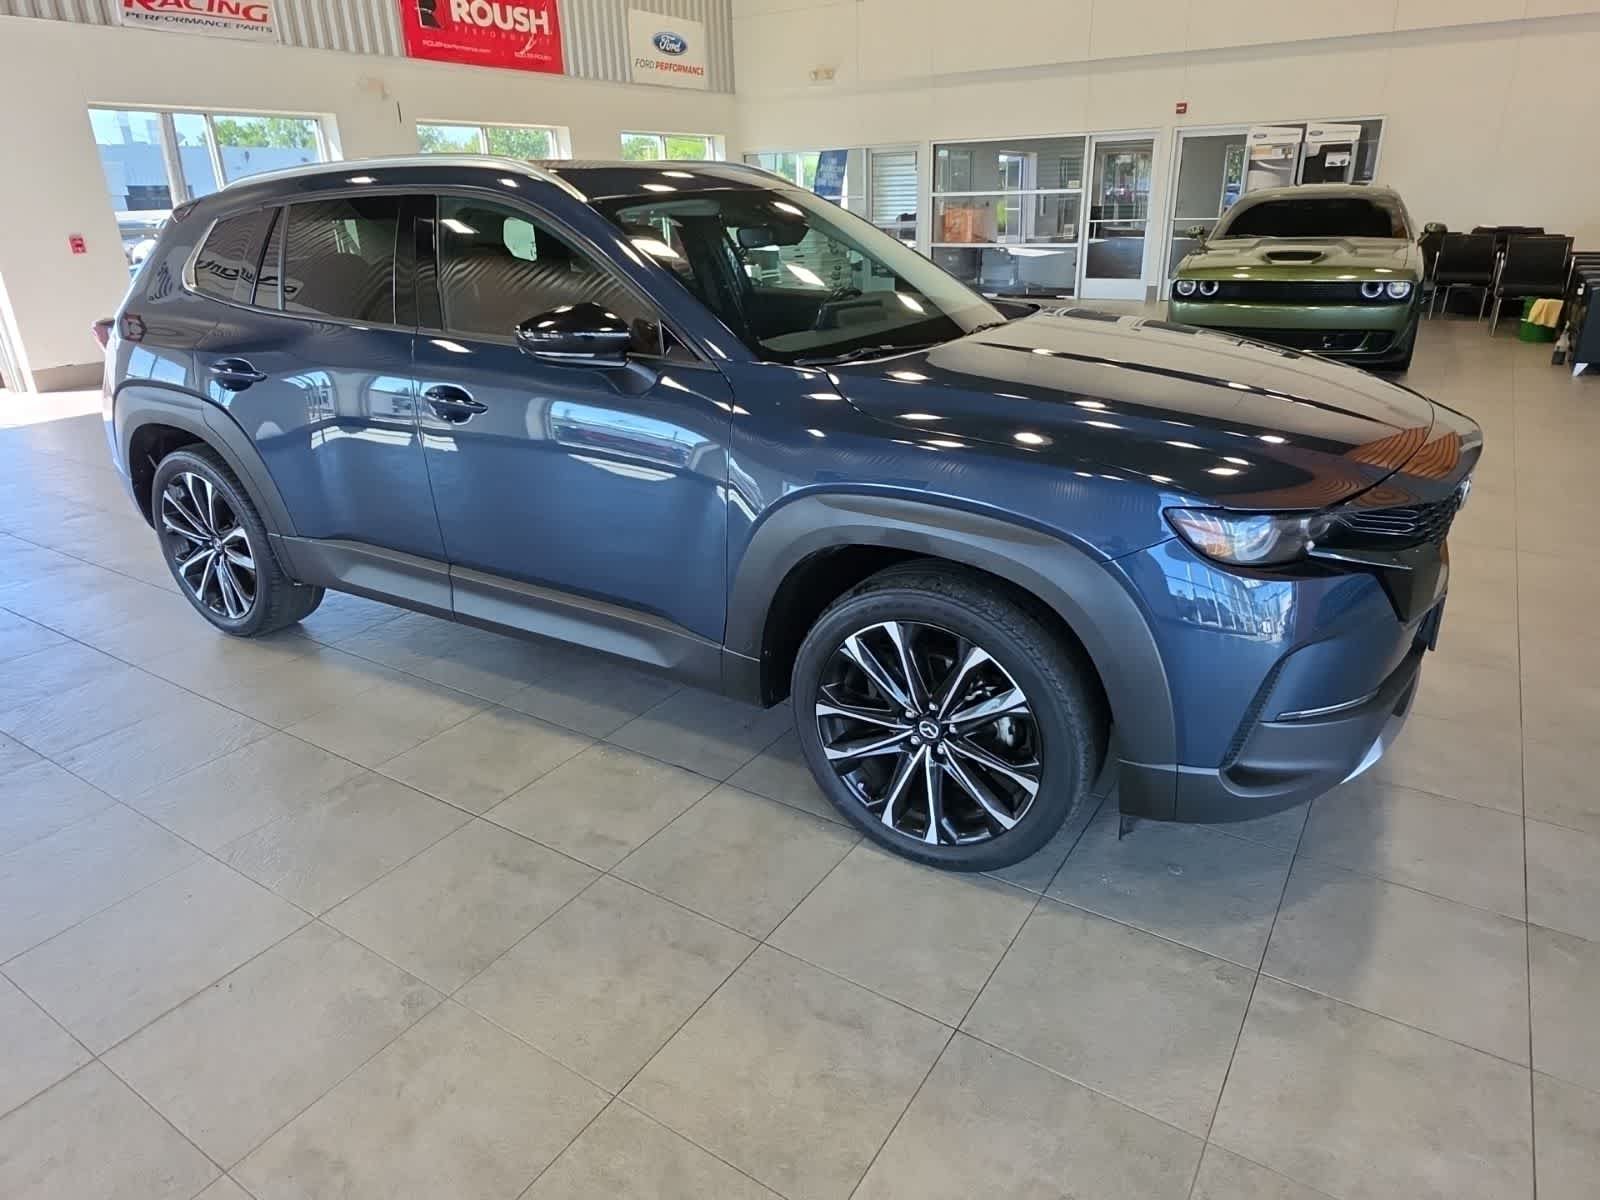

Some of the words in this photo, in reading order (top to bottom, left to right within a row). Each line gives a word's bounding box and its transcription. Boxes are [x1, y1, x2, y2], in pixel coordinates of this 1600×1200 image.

[125, 11, 232, 28] PERFORMANCE
[235, 23, 273, 33] PARTS
[450, 0, 549, 35] ROUSH
[659, 34, 681, 53] Ford
[634, 58, 655, 70] FORD
[655, 60, 704, 76] PERFORMANCE
